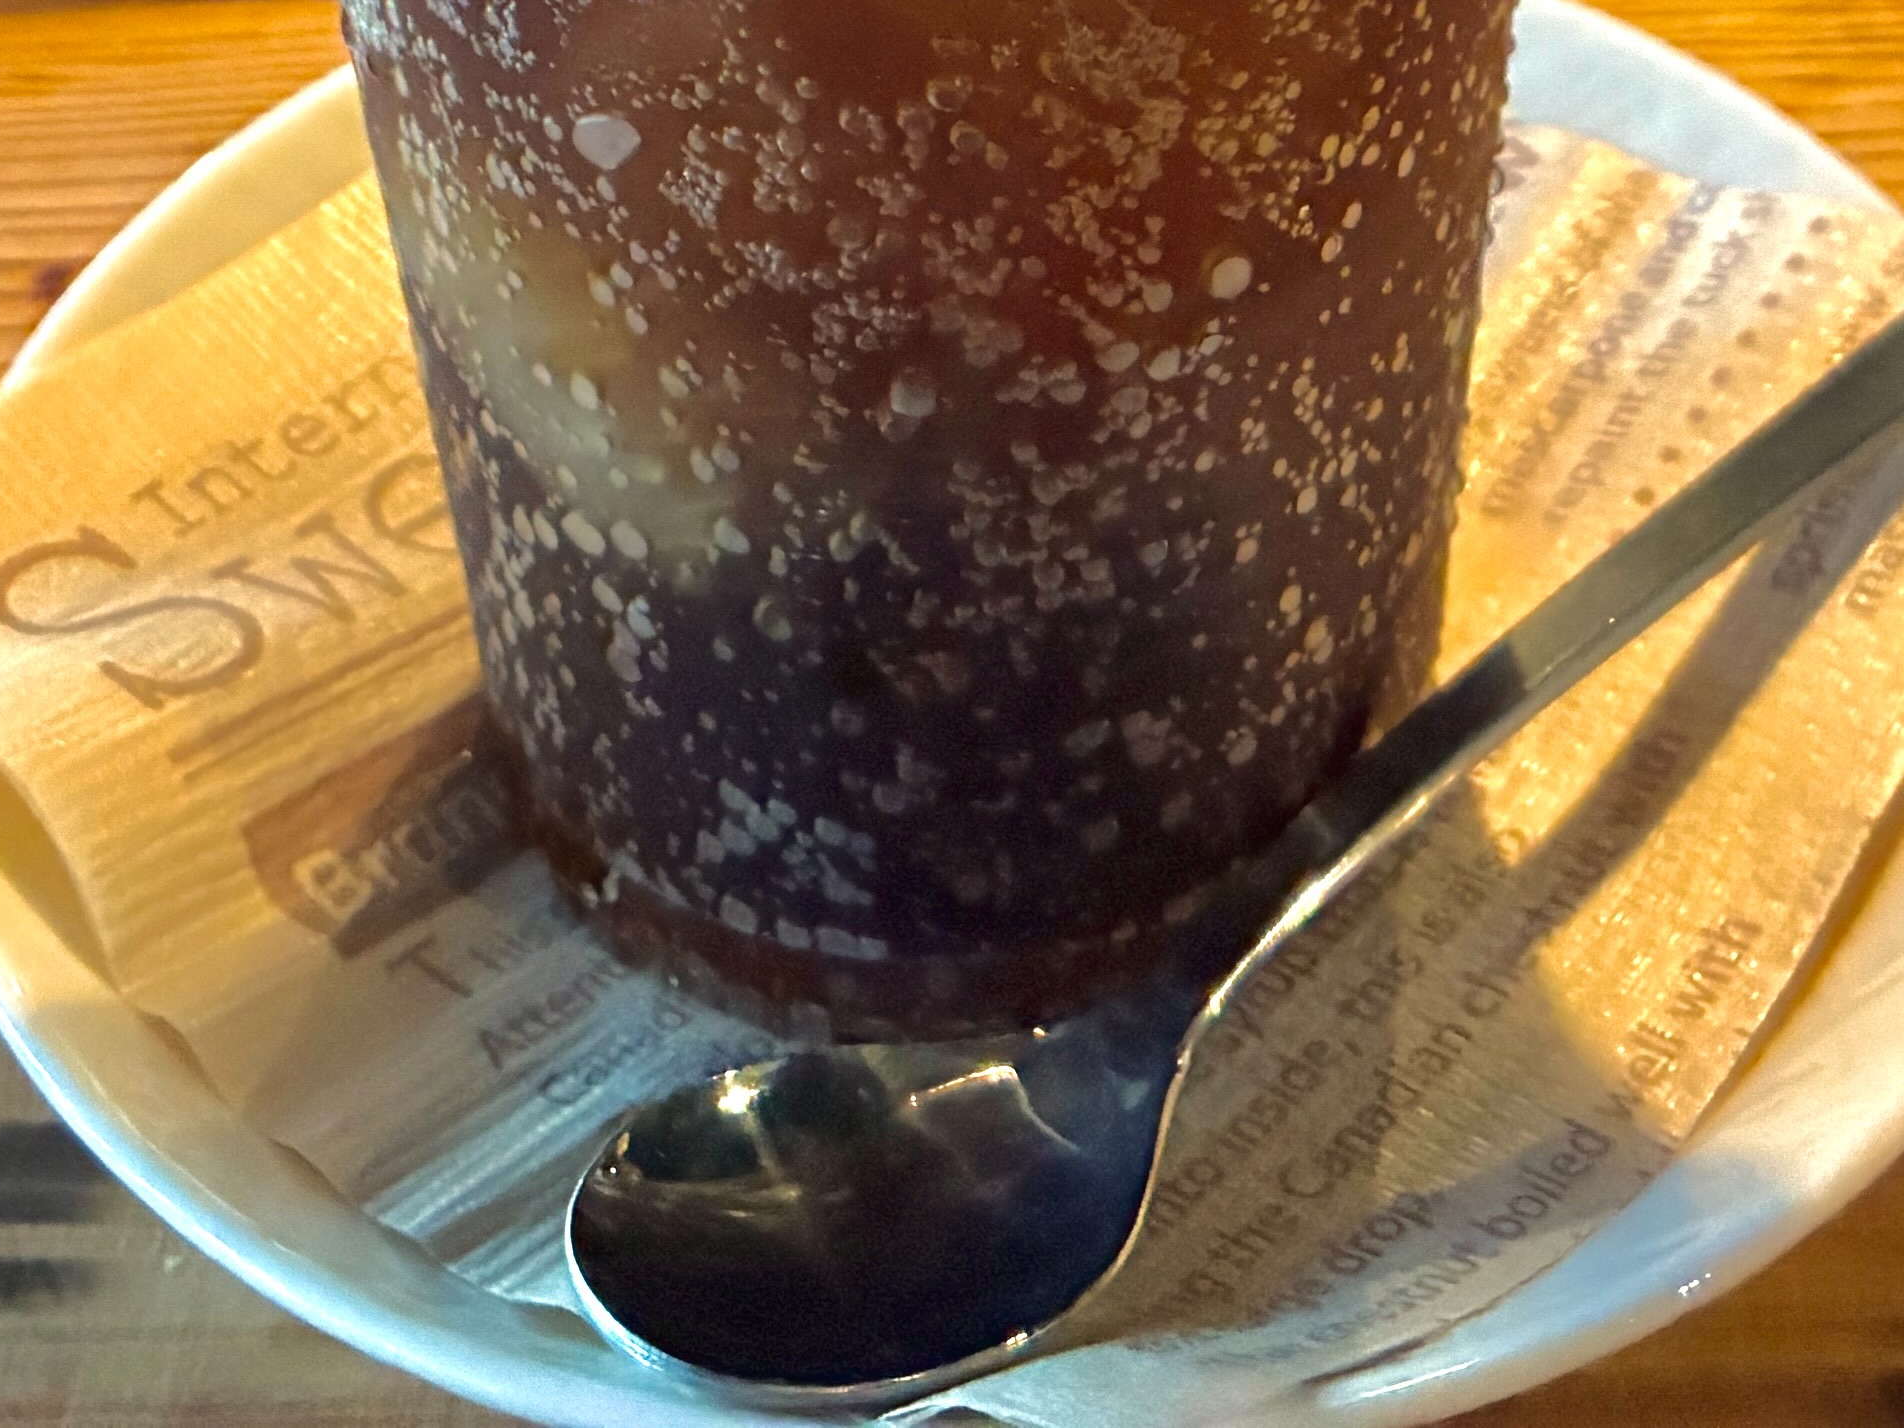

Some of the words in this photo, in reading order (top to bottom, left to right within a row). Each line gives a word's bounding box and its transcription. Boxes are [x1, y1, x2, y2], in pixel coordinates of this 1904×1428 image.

[1337, 948, 1425, 1024] this
[1279, 1020, 1473, 1200] Canadian
[1469, 1116, 1612, 1242] boiled
[1603, 1017, 1686, 1126] well
[1666, 907, 1764, 1022] with
[1322, 1191, 1436, 1275] drop
